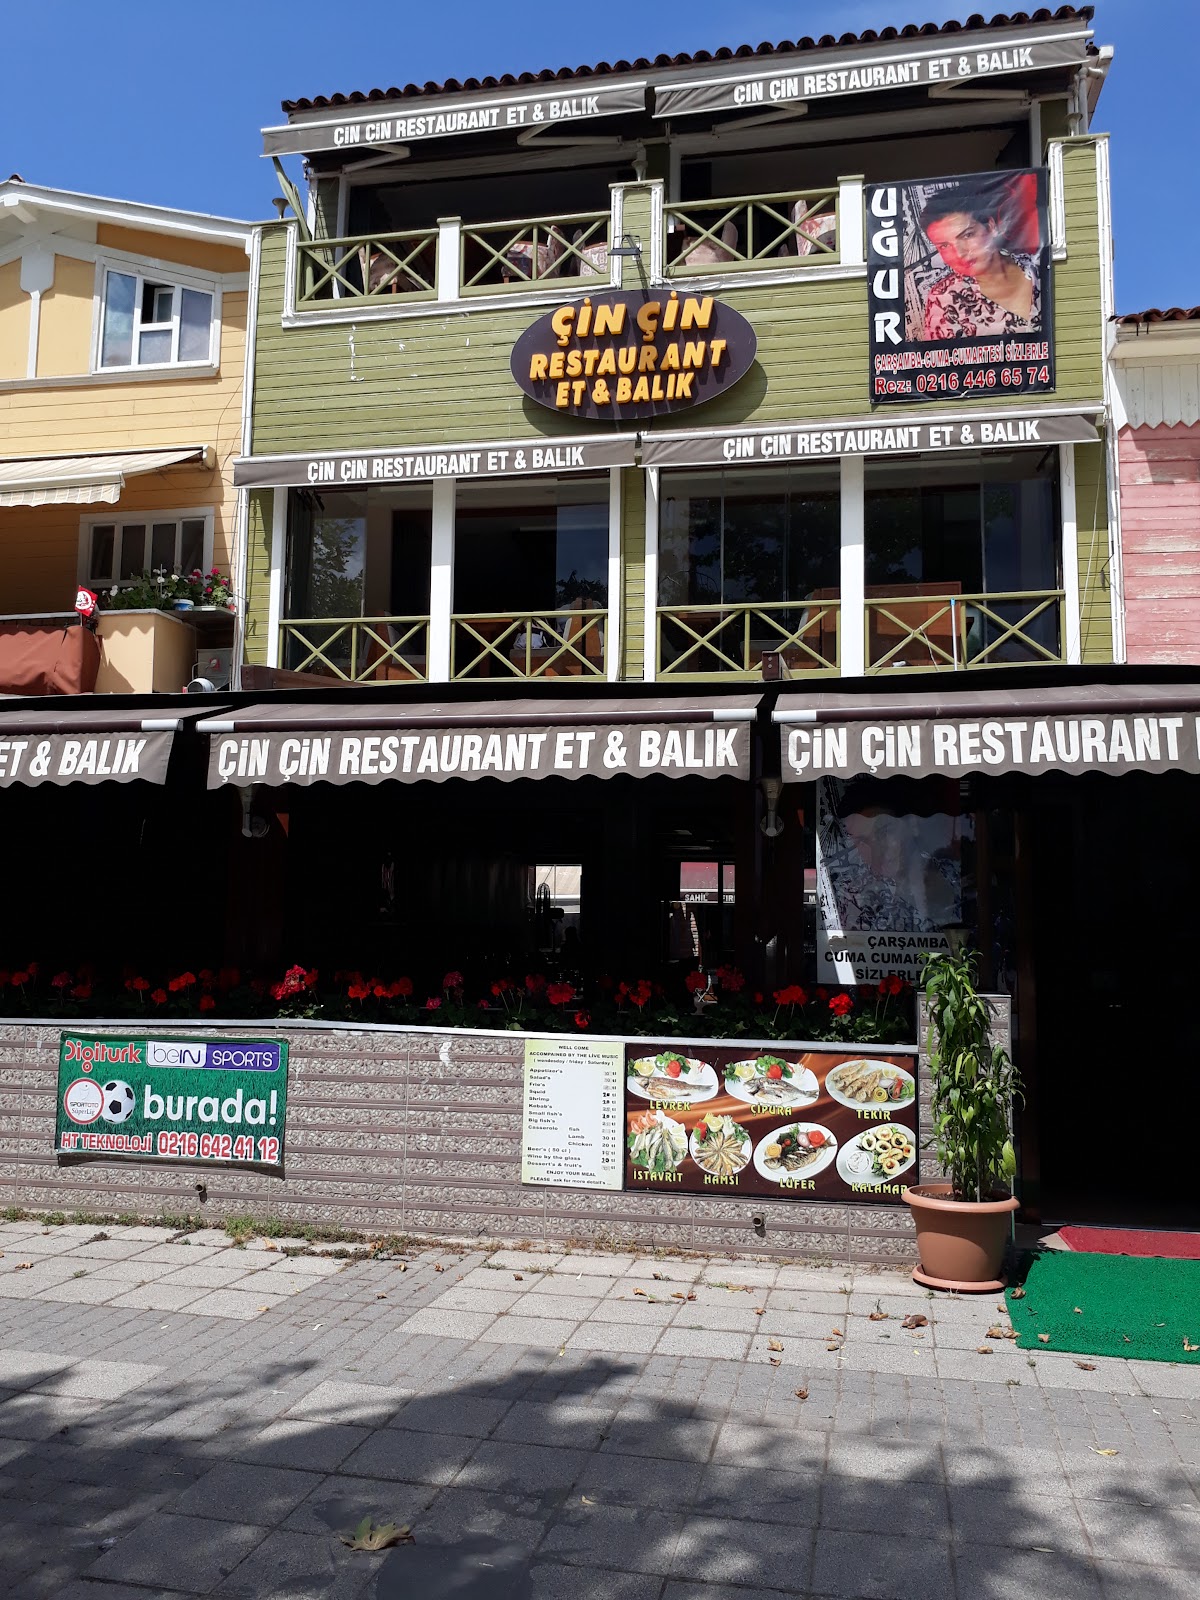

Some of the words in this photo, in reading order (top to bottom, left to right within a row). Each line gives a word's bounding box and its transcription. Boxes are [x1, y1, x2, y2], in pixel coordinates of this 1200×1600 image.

[804, 63, 921, 95] RESTAURANT
[928, 58, 951, 79] ET
[957, 56, 971, 76] &
[977, 48, 1033, 74] BALIK
[396, 109, 499, 138] RESTAURANT
[507, 105, 527, 124] ET
[532, 103, 544, 121] &
[550, 96, 599, 119] BALIK
[551, 298, 626, 346] ÇİN
[637, 291, 714, 341] ÇİN
[530, 340, 727, 381] RESTAURANT
[1005, 340, 1049, 361] SİZLERLE
[555, 380, 586, 407] ET
[592, 379, 610, 404] &
[616, 372, 694, 403] BALIK
[875, 377, 911, 395] Rez:
[916, 372, 959, 393] 0216
[963, 369, 996, 388] 446
[1001, 368, 1022, 386] 65
[1027, 366, 1049, 385] 74
[797, 426, 919, 455] RESTAURANT
[929, 425, 952, 447] ET
[960, 423, 974, 444] &
[980, 420, 1042, 442] BALIK
[373, 452, 481, 478] RESTAURANT
[488, 451, 507, 471] ET
[514, 450, 526, 468] &
[532, 446, 584, 468] BALIK
[29, 741, 51, 776] &
[58, 739, 147, 776] BALIK
[339, 733, 547, 774] RESTAURANT
[554, 732, 596, 770] ET
[603, 730, 627, 769] &
[639, 728, 738, 768] BALIK
[933, 717, 1183, 766] RESTAURANT
[825, 951, 866, 963] CUMA
[867, 935, 949, 950] ÇARŞAMBA
[64, 1040, 142, 1073] Digiturk
[212, 1050, 272, 1068] SPORTS
[144, 1085, 277, 1125] burada!
[649, 1100, 691, 1111] LEVREK
[750, 1103, 792, 1116] ÇİPURA
[856, 1108, 891, 1121] TEKİR
[61, 1132, 78, 1149] HT
[158, 1131, 197, 1157] 0216
[201, 1134, 232, 1159] 642
[233, 1136, 254, 1160] 41
[259, 1136, 279, 1161] 12
[633, 1169, 683, 1183] İSTAVRİT
[704, 1173, 739, 1186] HAMSİ
[779, 1177, 815, 1190] LÜFER
